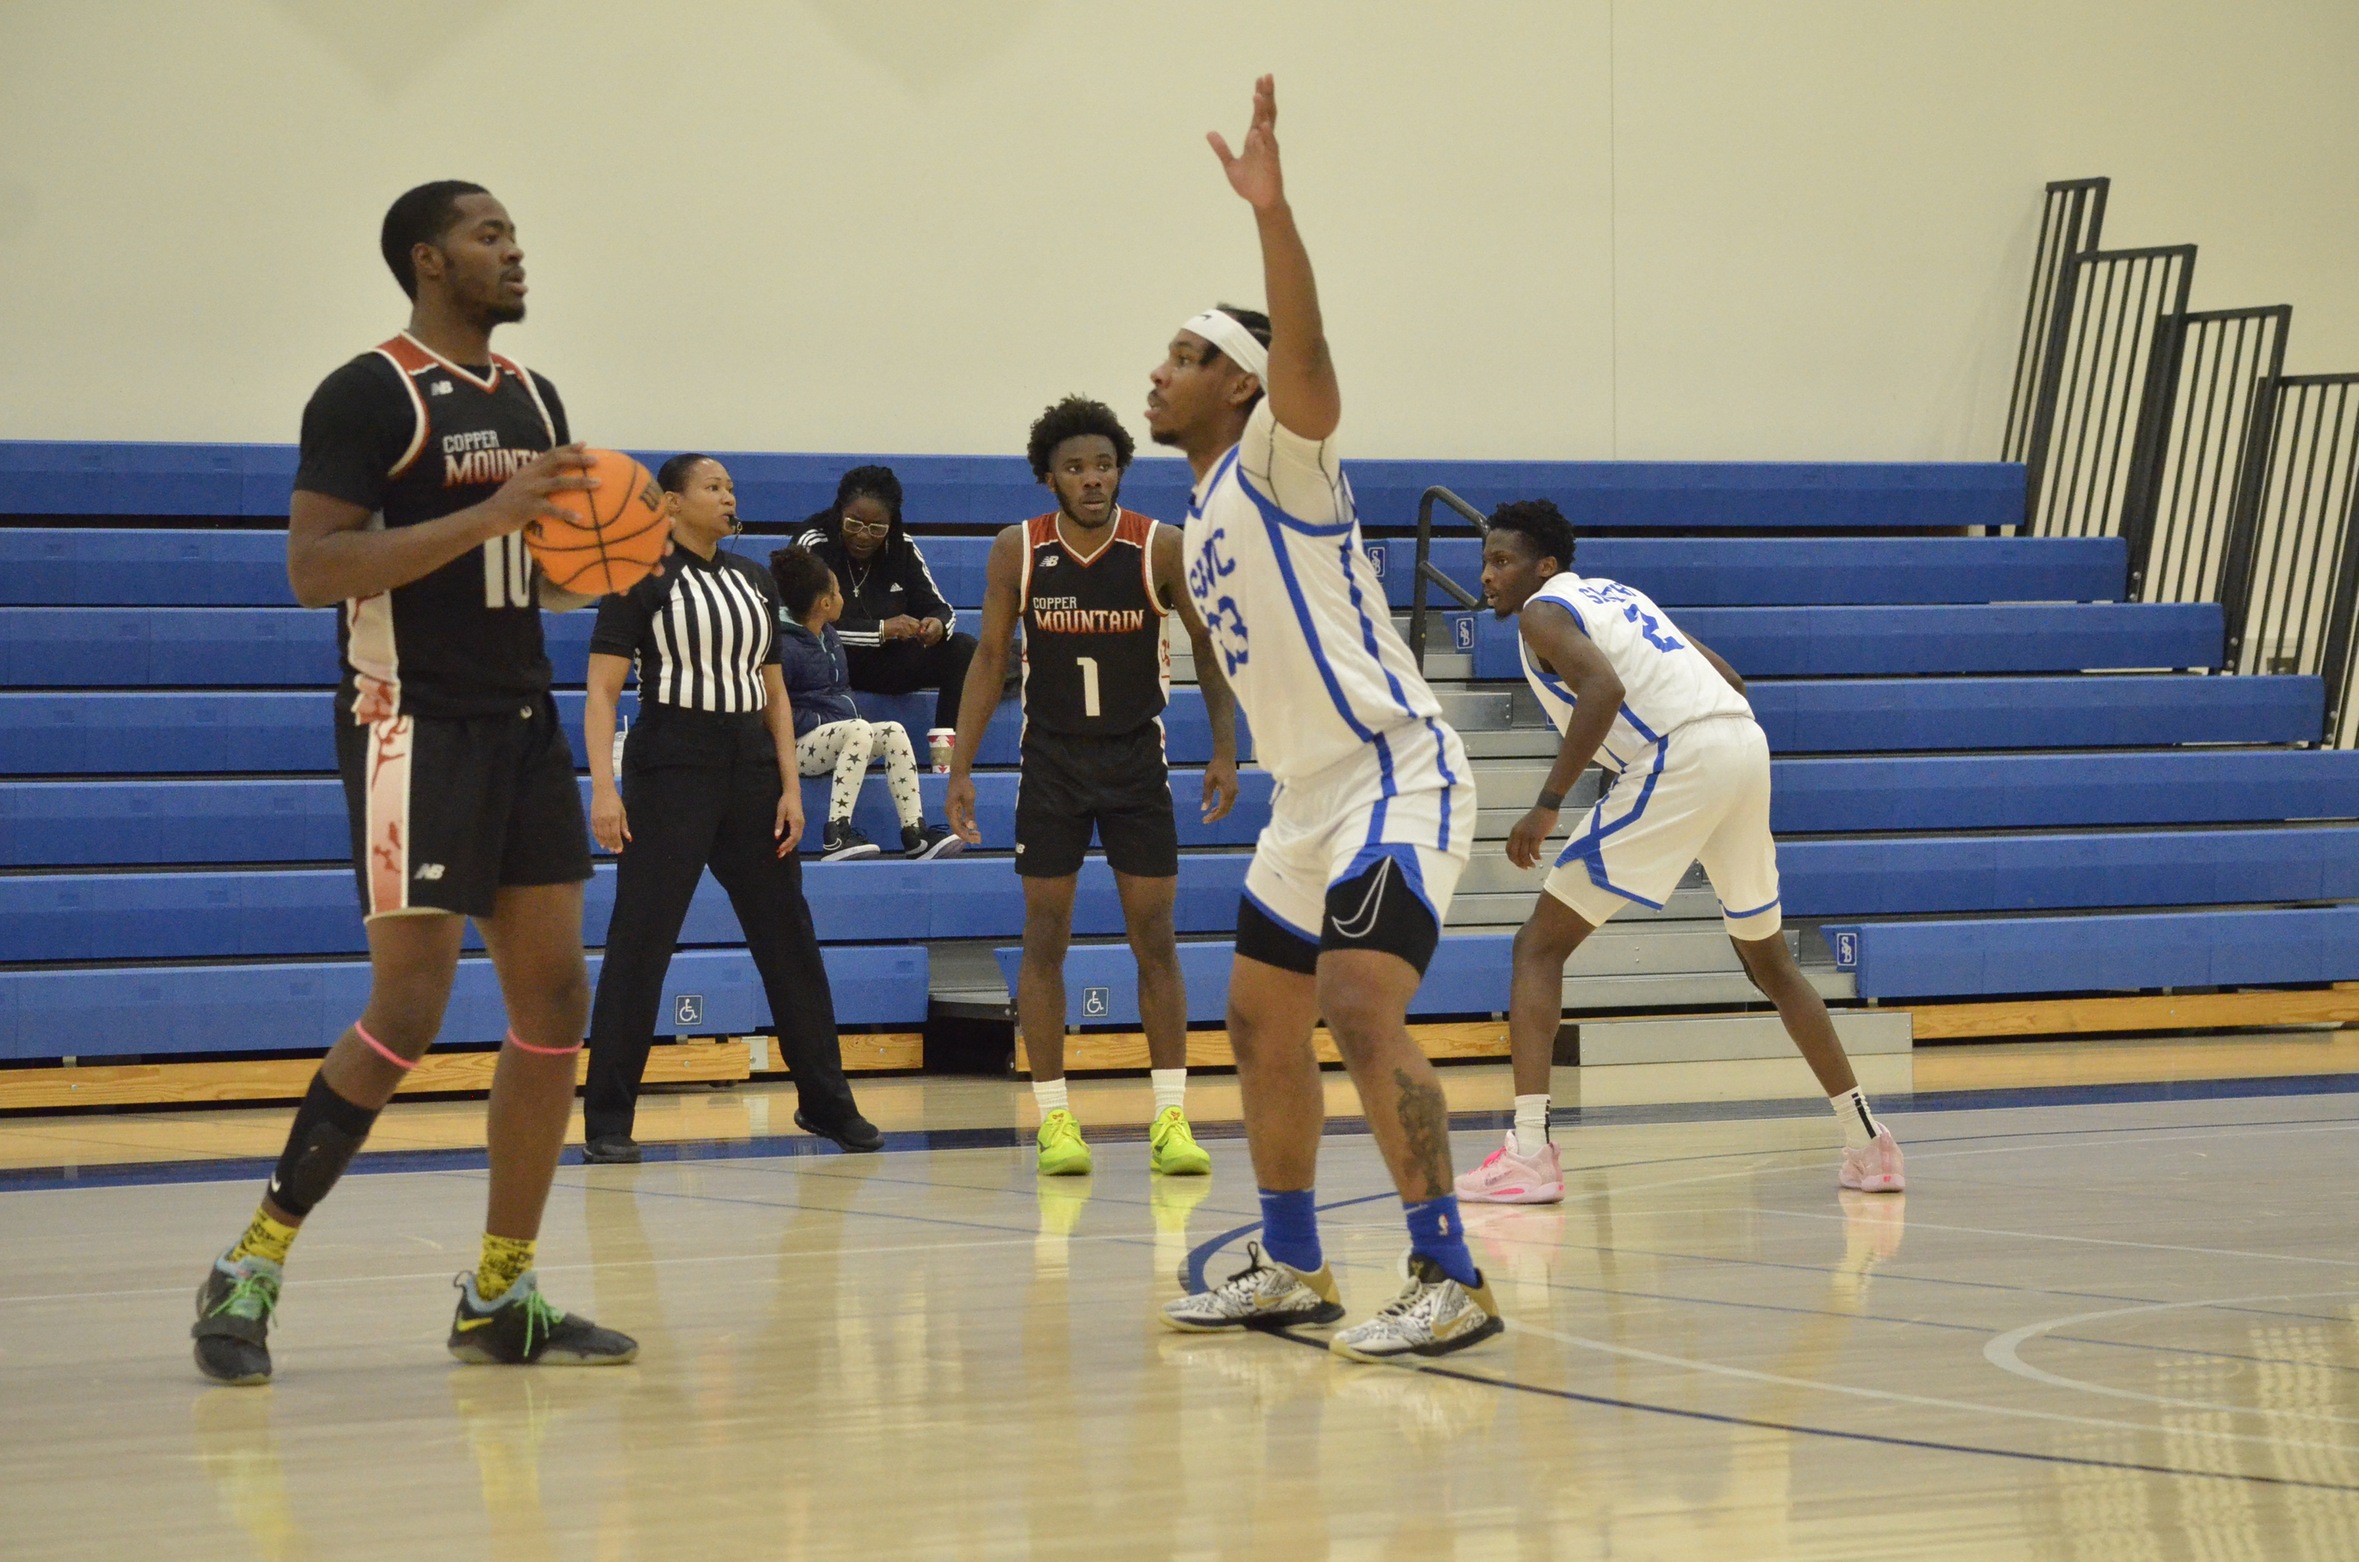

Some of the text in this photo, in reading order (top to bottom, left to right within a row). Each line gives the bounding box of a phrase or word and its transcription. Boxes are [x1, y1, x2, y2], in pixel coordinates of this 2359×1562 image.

[443, 430, 500, 453] COPPER
[444, 448, 545, 488] MOUNT
[484, 526, 533, 608] 10
[1033, 596, 1077, 610] COPPER
[1034, 609, 1145, 634] MOUNTAIN
[1623, 603, 1685, 653] 2
[1077, 656, 1100, 717] 1
